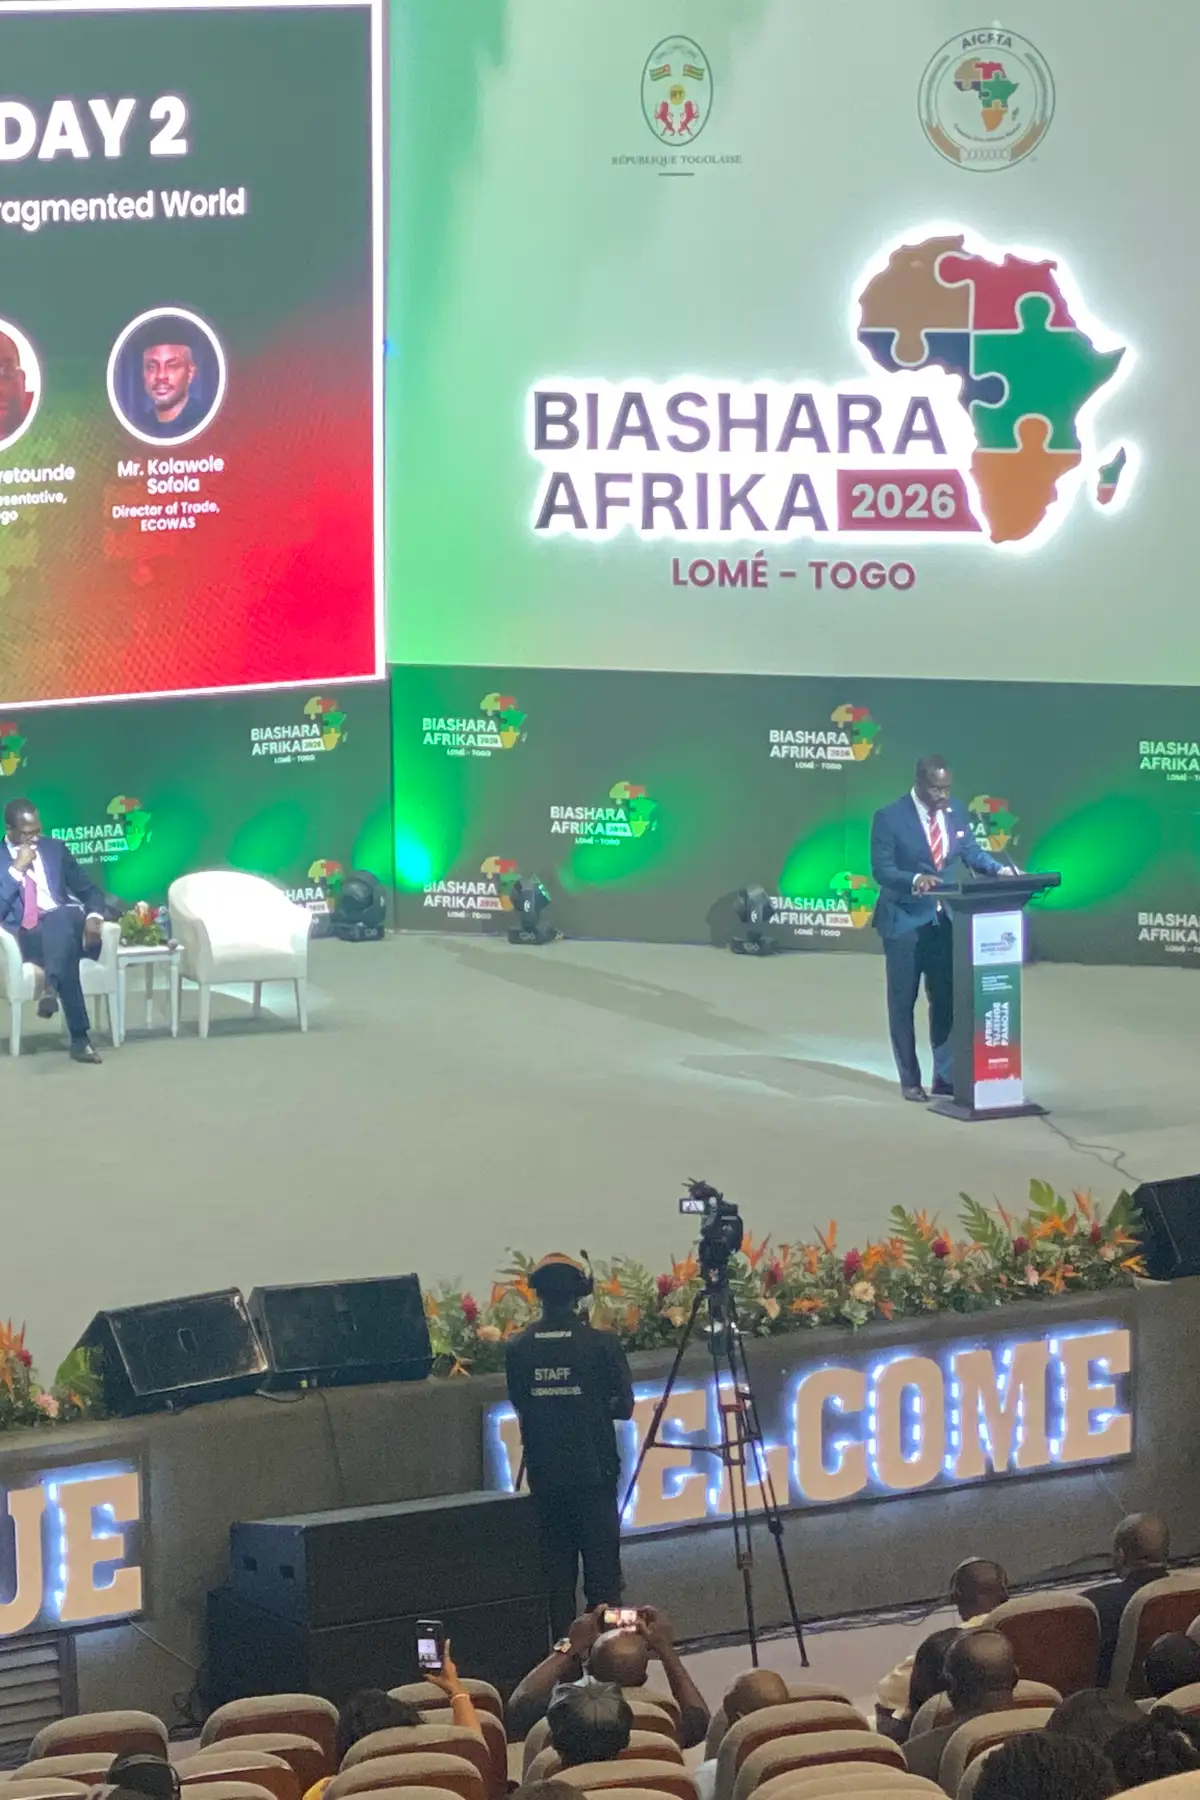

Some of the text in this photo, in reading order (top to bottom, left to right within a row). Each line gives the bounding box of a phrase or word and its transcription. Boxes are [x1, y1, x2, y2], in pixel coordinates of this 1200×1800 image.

[962, 33, 1012, 50] AfCFTA
[149, 96, 189, 155] 2
[161, 188, 246, 217] World
[534, 391, 948, 455] BIASHARA
[117, 455, 224, 477] Mr. Kolawole
[147, 476, 200, 494] Sofola
[112, 501, 220, 518] Director of Trade,
[534, 471, 956, 532] AFRIKA 2026
[140, 517, 196, 531] ECOWAS
[672, 549, 769, 588] LOMÉ
[809, 561, 916, 591] TOGO
[250, 723, 320, 741] BIASHARA
[422, 717, 498, 733] BIASHARA
[423, 732, 477, 746] AFRIKA
[769, 729, 850, 745] BIASHARA
[252, 740, 301, 756] AFRIKA
[770, 745, 827, 759] AFRIKA
[1139, 741, 1200, 756] BIASHA
[1140, 757, 1200, 771] AFRIKA
[550, 806, 627, 821] BIASHARA
[550, 820, 606, 835] AFRIKA
[423, 895, 478, 909] AFRIKA
[769, 912, 826, 926] AFRIKA
[1138, 912, 1200, 928] BIASHA
[1138, 928, 1199, 942] AFRIKA
[534, 1367, 571, 1381] STAFF
[497, 1329, 1132, 1527] ELCOME
